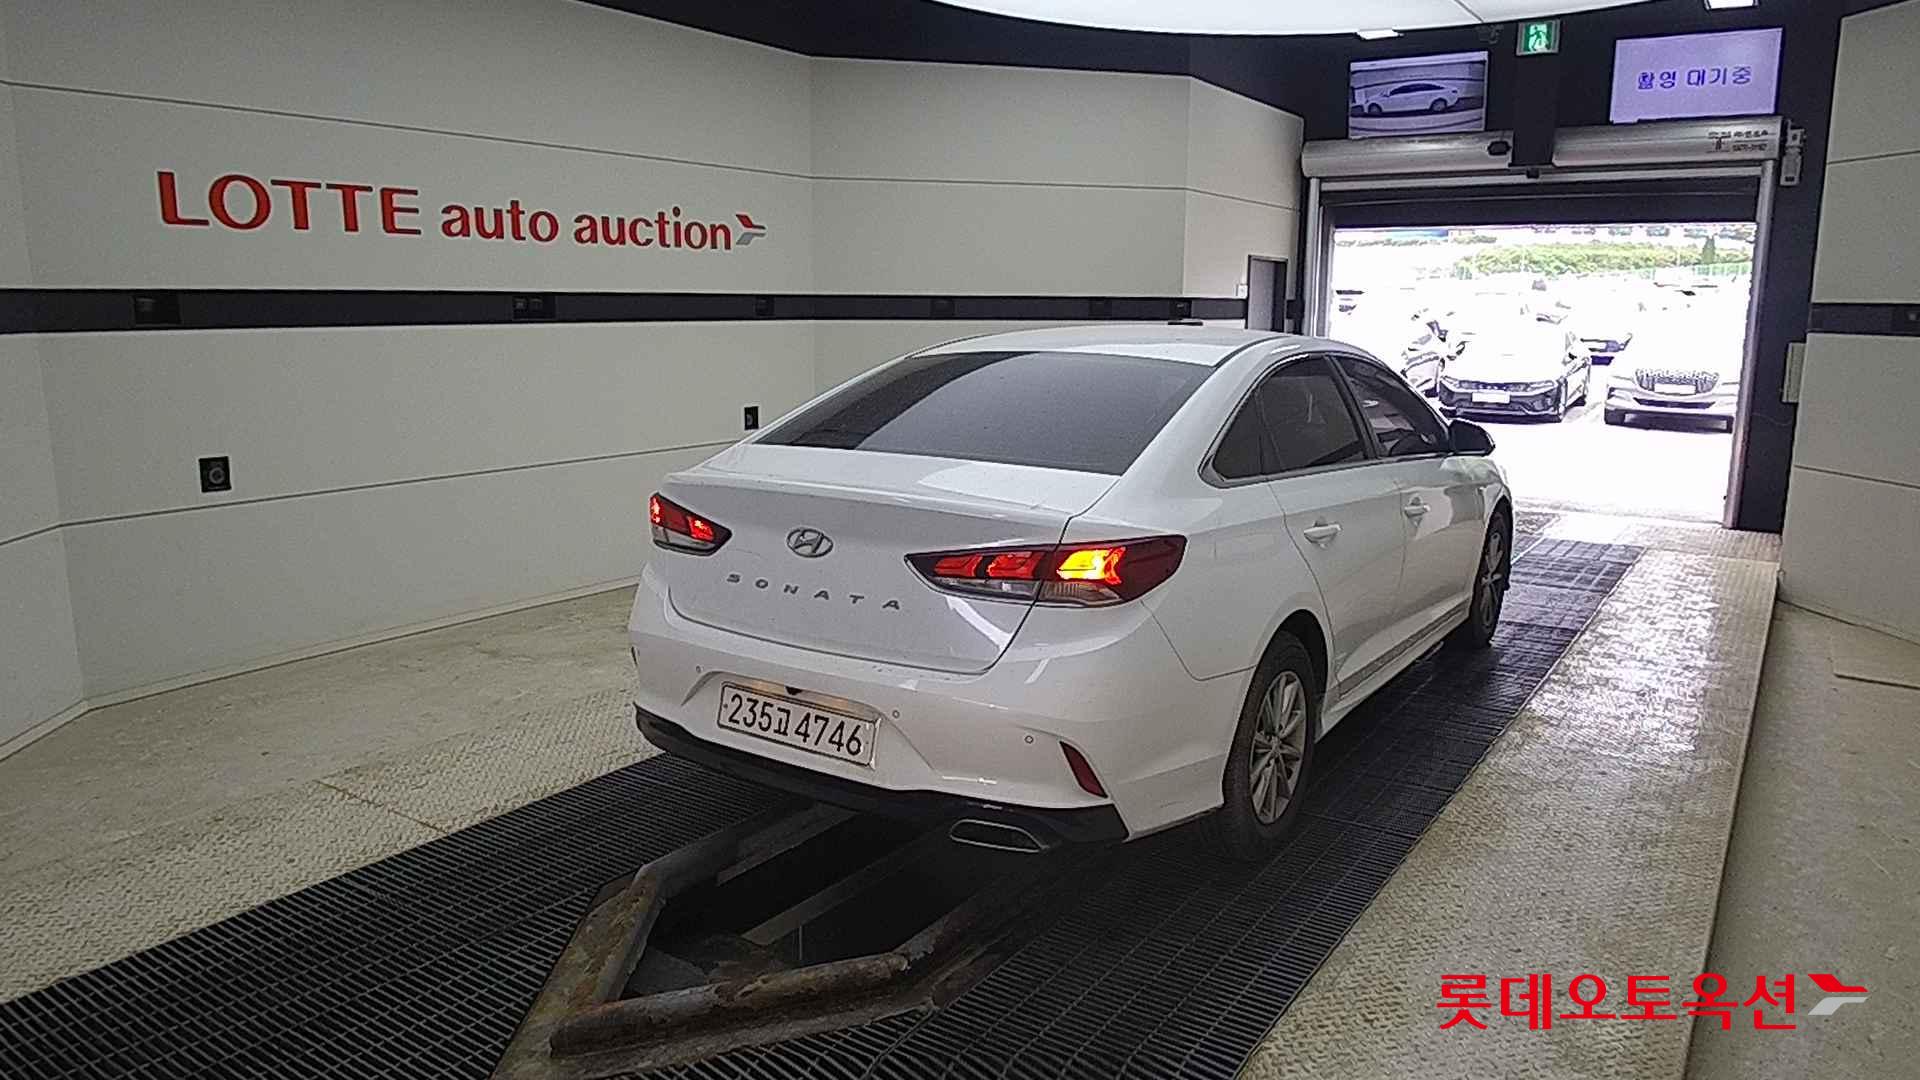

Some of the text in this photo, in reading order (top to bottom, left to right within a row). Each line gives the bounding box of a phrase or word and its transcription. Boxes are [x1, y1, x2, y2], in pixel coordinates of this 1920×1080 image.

[1687, 66, 1752, 86] 대기중
[156, 171, 733, 251] LOTTE auto auction
[726, 573, 900, 610] SONATA
[728, 693, 862, 756] 235고4746
